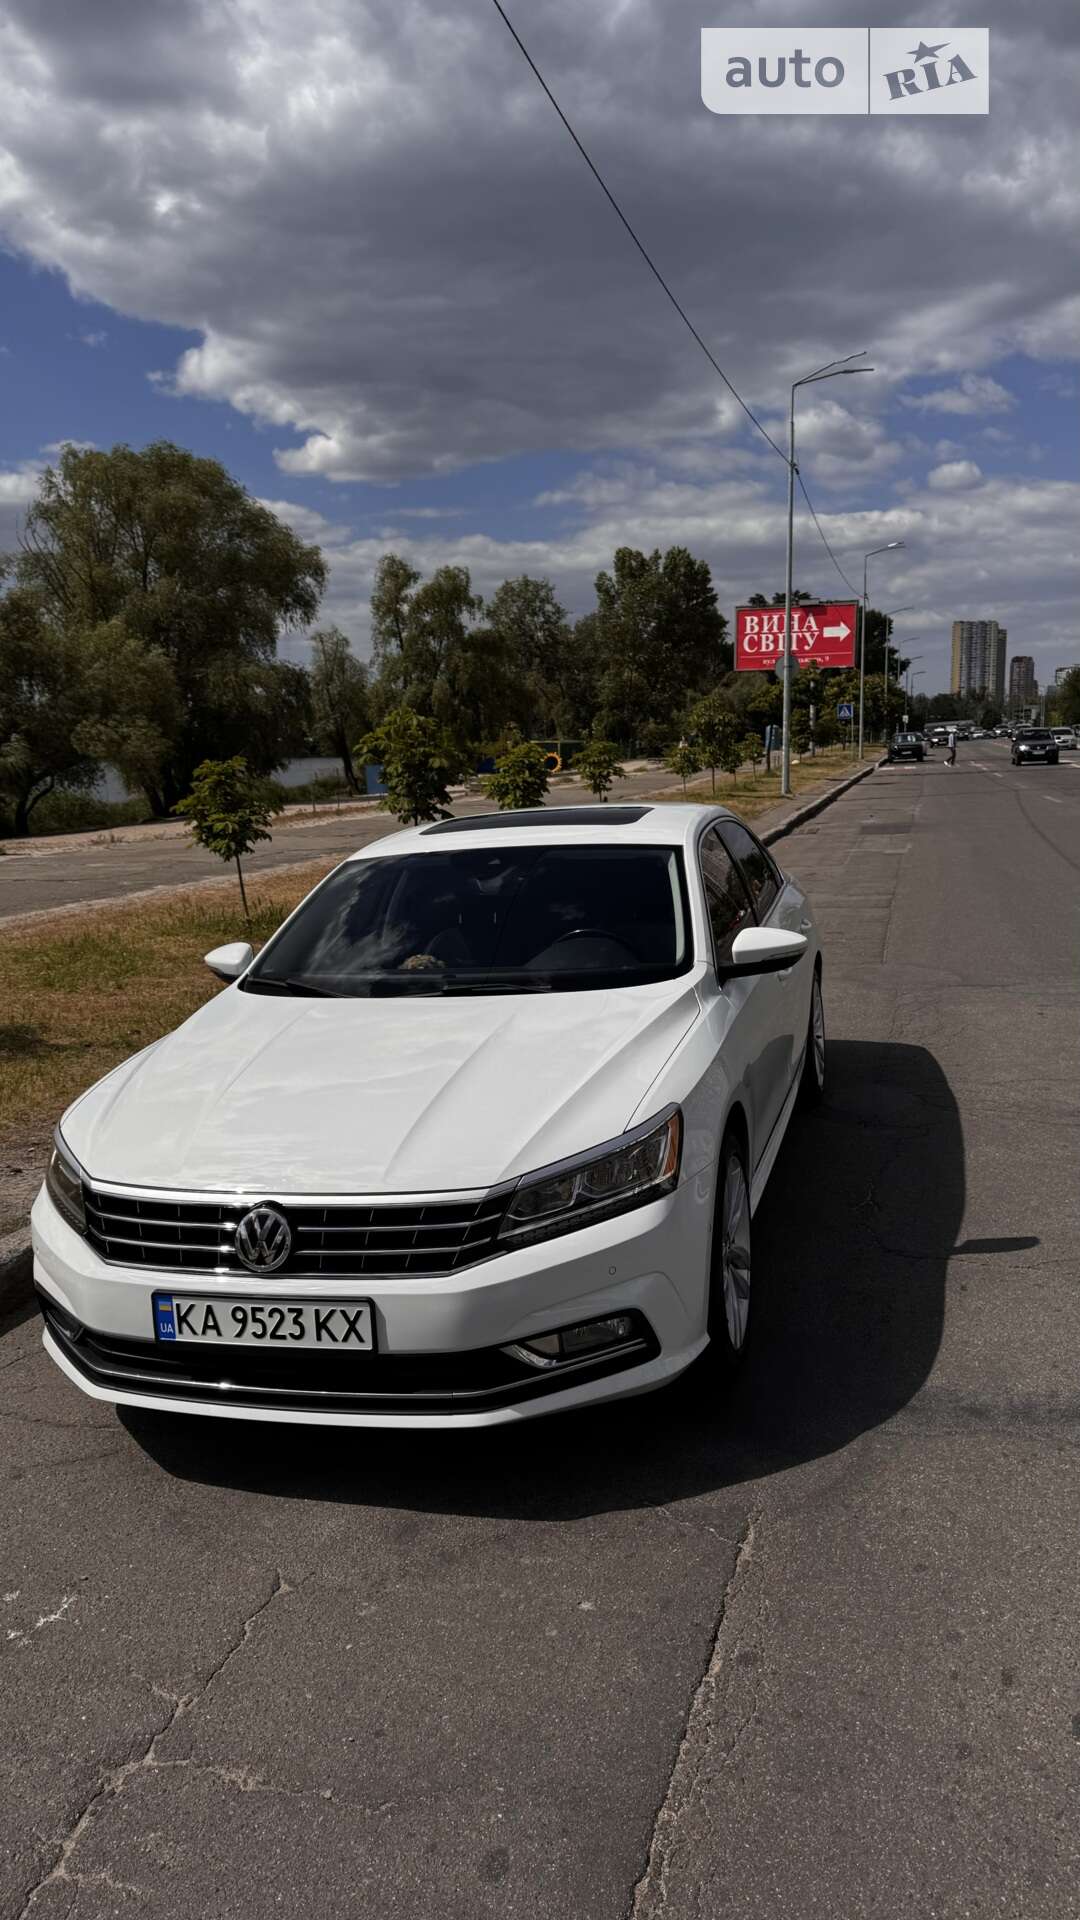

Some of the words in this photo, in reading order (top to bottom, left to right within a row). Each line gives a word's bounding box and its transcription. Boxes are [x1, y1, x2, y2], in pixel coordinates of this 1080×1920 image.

[744, 612, 820, 634] ВИНА
[160, 1323, 174, 1334] UA
[175, 1303, 223, 1337] KA
[231, 1306, 306, 1341] 9523
[314, 1308, 366, 1343] KX
